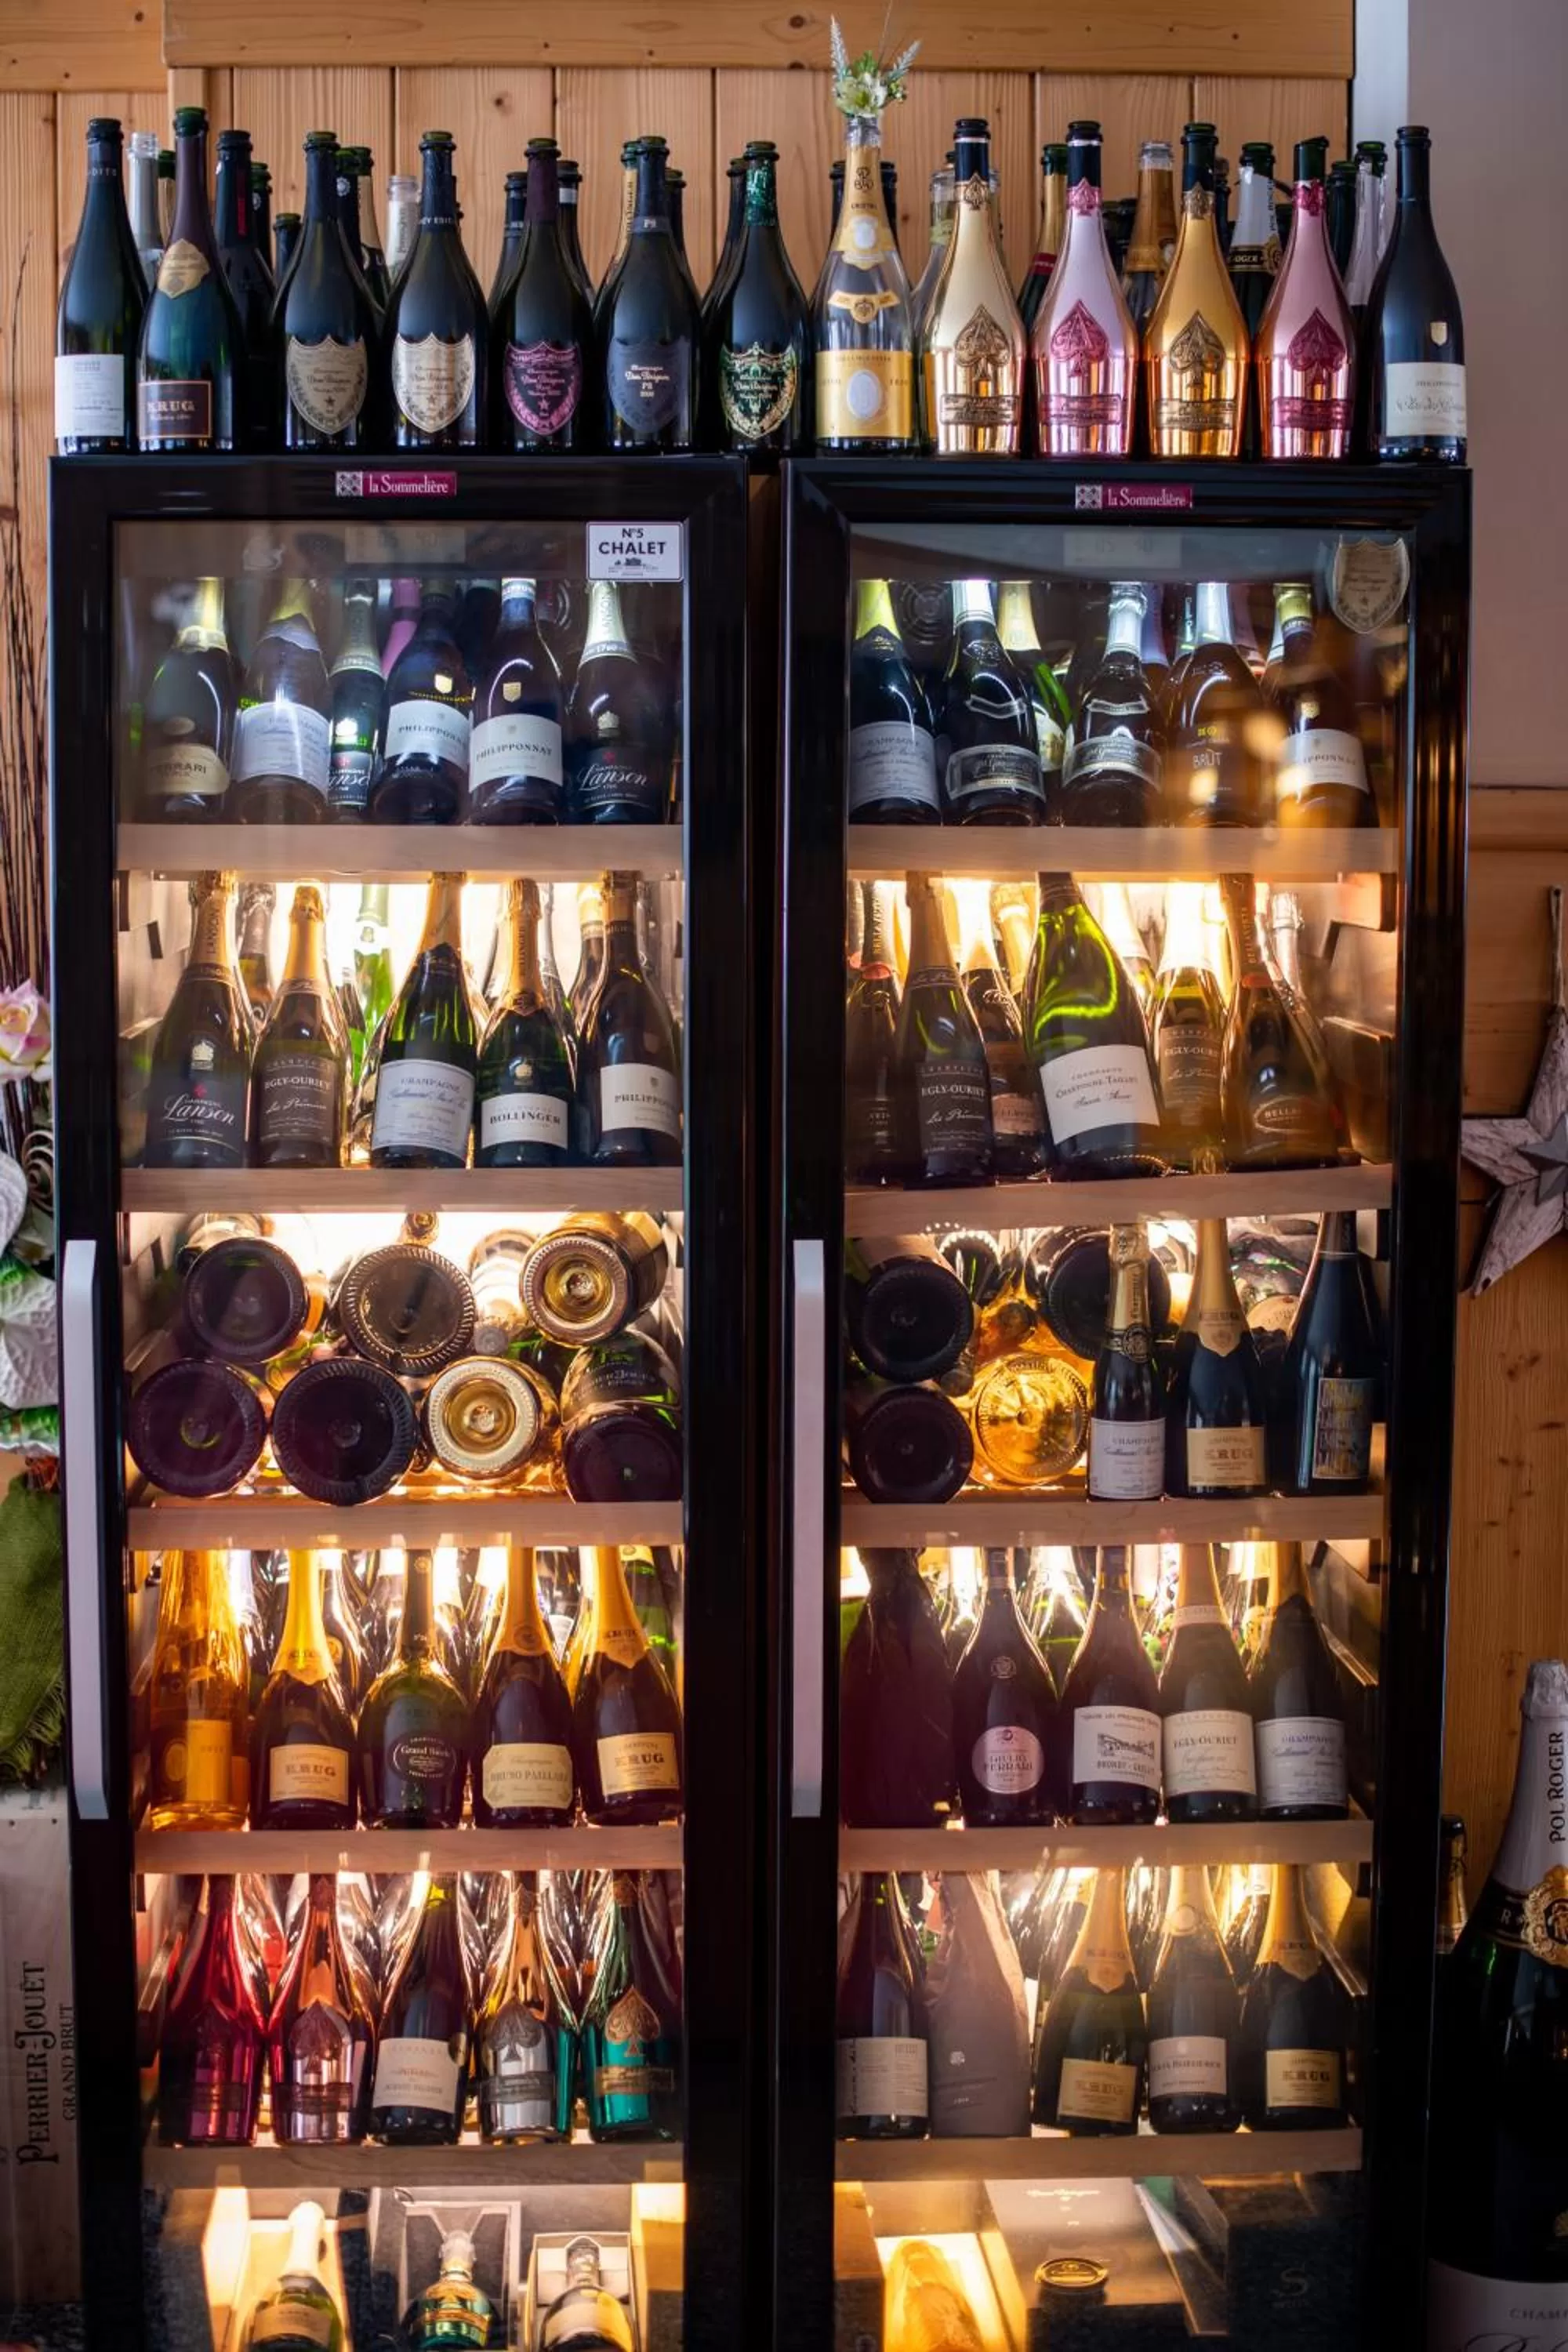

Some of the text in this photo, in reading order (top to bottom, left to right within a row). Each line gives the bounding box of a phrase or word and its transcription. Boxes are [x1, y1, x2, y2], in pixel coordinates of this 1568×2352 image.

[147, 400, 195, 413] KRUG
[369, 474, 448, 494] la Sommelière
[1108, 487, 1186, 507] la Sommelière
[598, 542, 666, 554] CHALET
[476, 743, 552, 760] PHILIPPONNAT
[1192, 750, 1222, 769] BRUT
[577, 763, 648, 791] Lanson
[163, 1093, 235, 1124] Lanson
[490, 1111, 561, 1125] BOLLINGER
[1204, 1448, 1254, 1461] KRUG
[615, 1752, 665, 1767] KRUG
[285, 1764, 336, 1777] KRUG
[490, 1770, 521, 1783] BRUNO
[1548, 1733, 1566, 1844] POL ROGER
[59, 2004, 75, 2122] GRAND BRUT
[1282, 2070, 1331, 2082] KRUG
